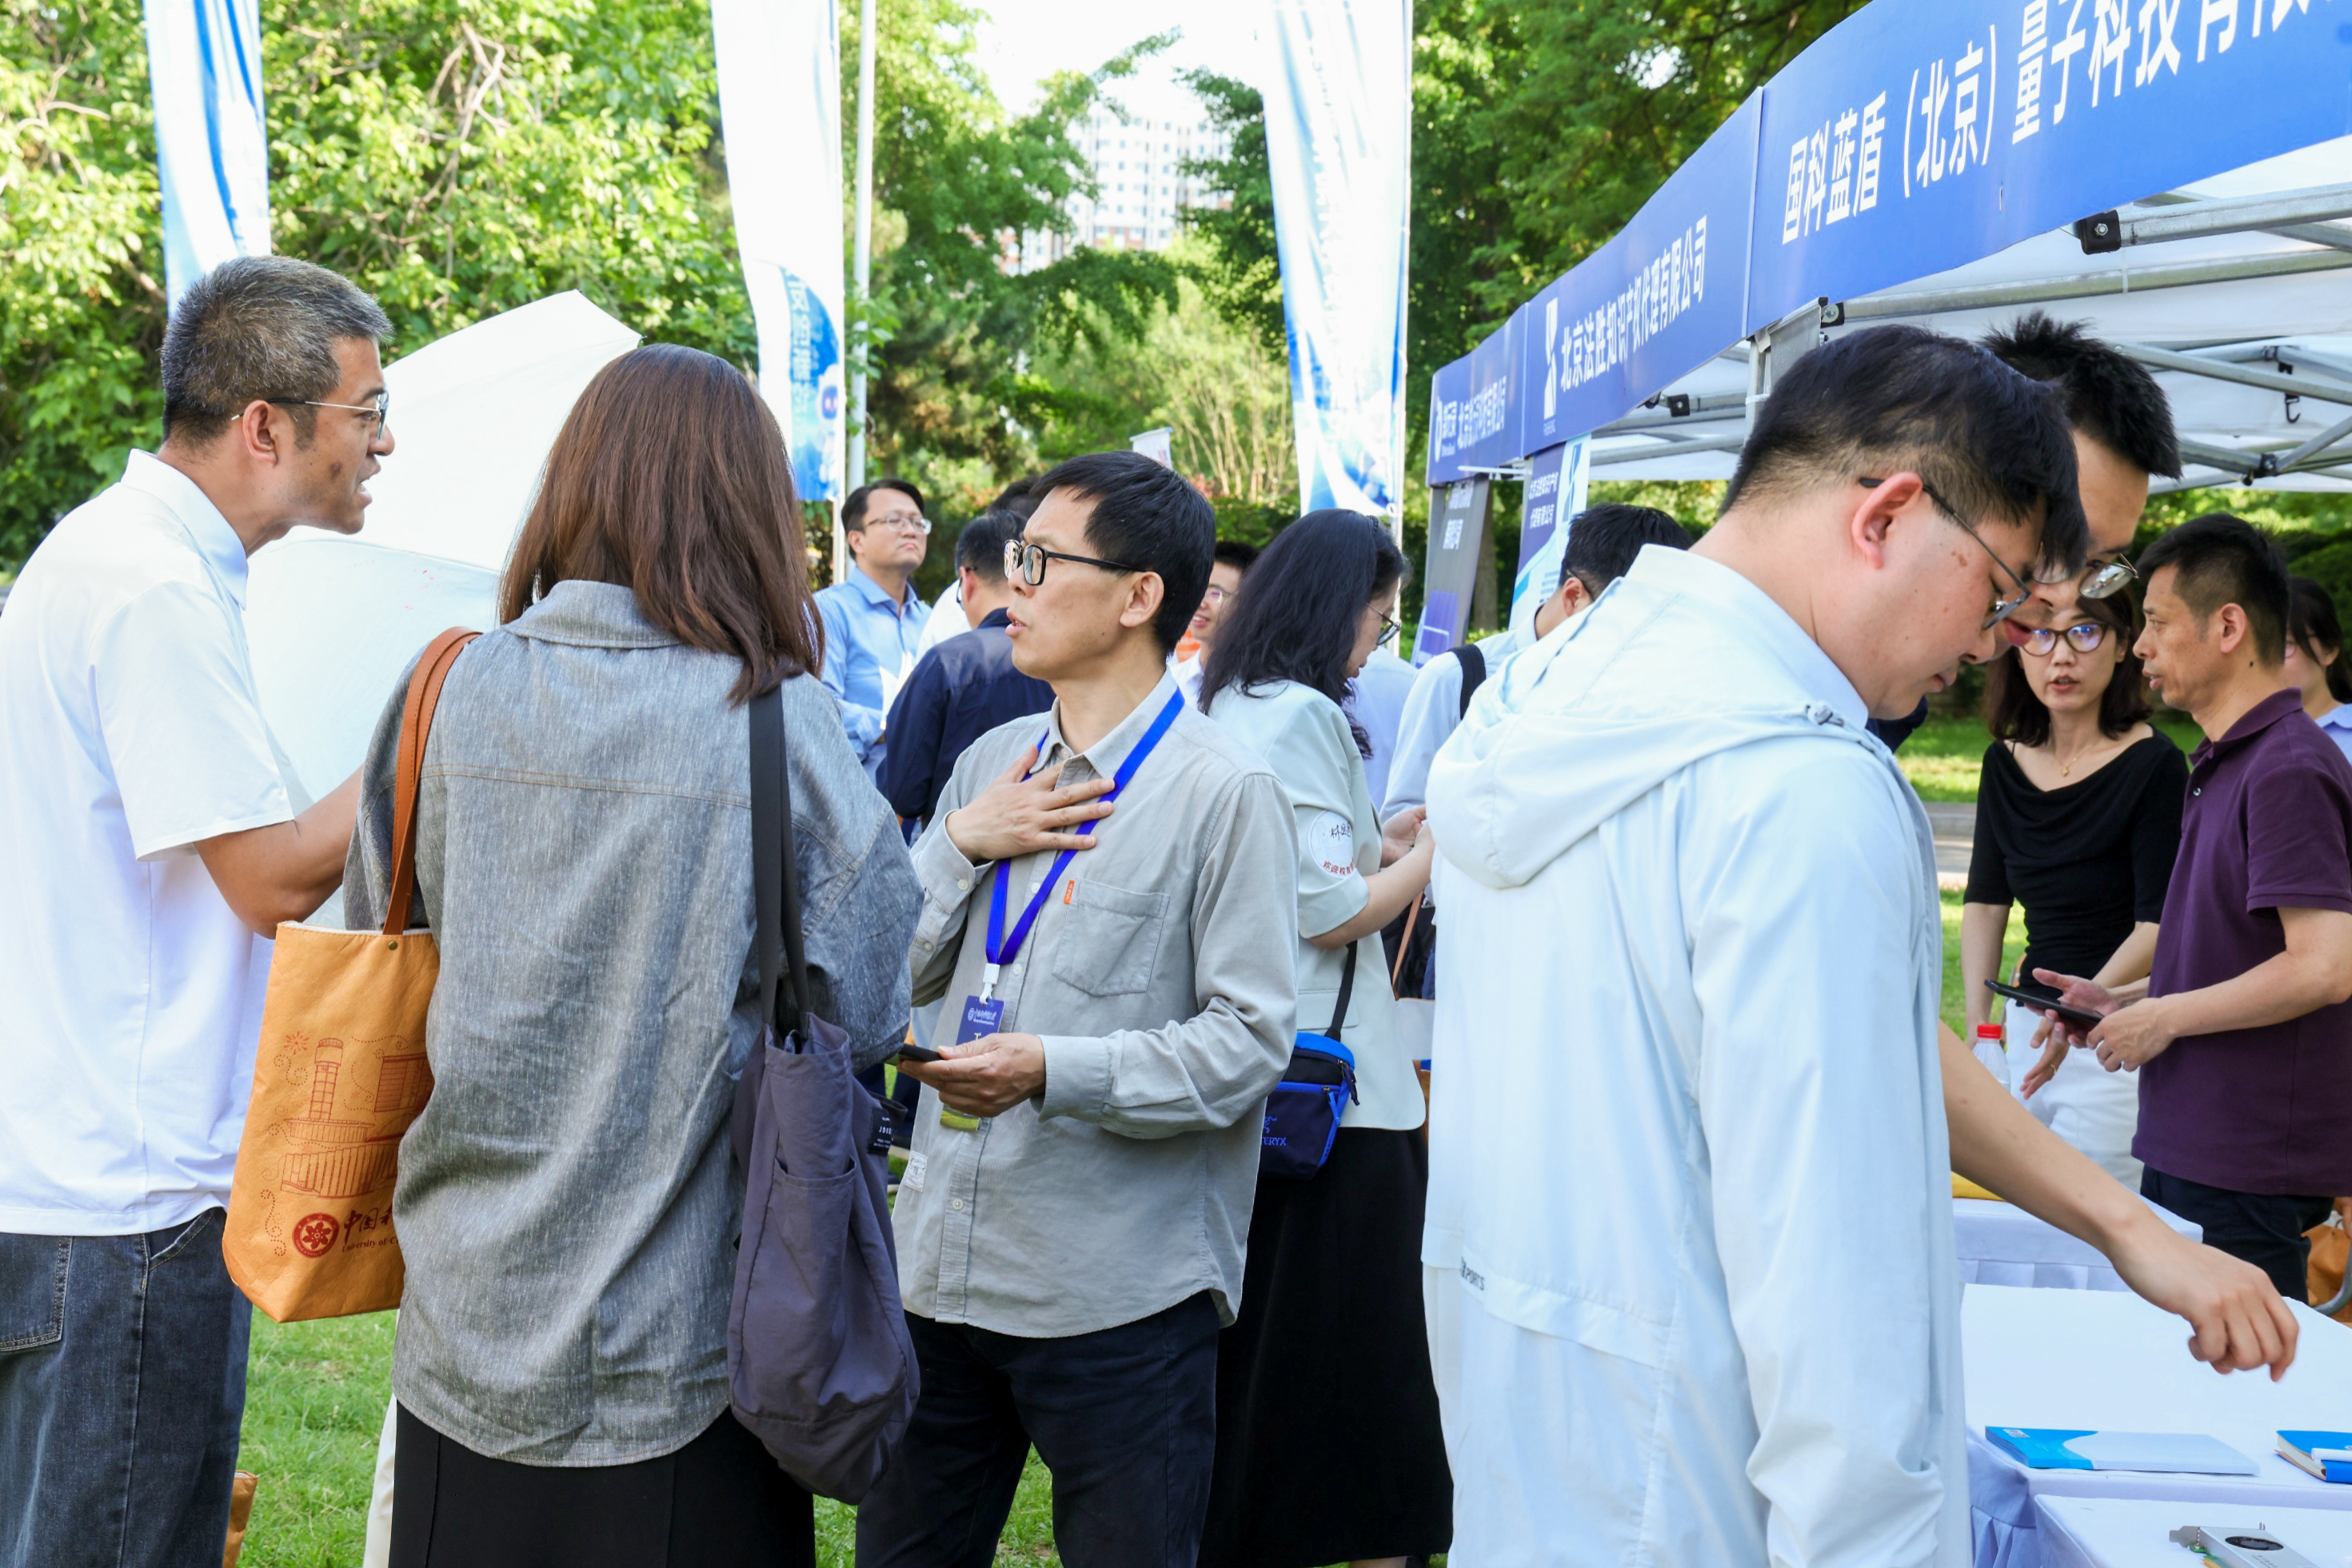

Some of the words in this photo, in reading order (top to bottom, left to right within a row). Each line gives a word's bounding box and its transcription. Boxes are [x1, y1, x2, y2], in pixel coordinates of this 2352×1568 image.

[1782, 0, 2311, 245] 国科蓝盾（北京）量子科技
[1560, 214, 1708, 393] 北京法胜知识产权代理有限公司
[1324, 857, 1355, 876] 欢迎校友
[341, 1239, 377, 1253] University
[378, 1237, 388, 1246] of
